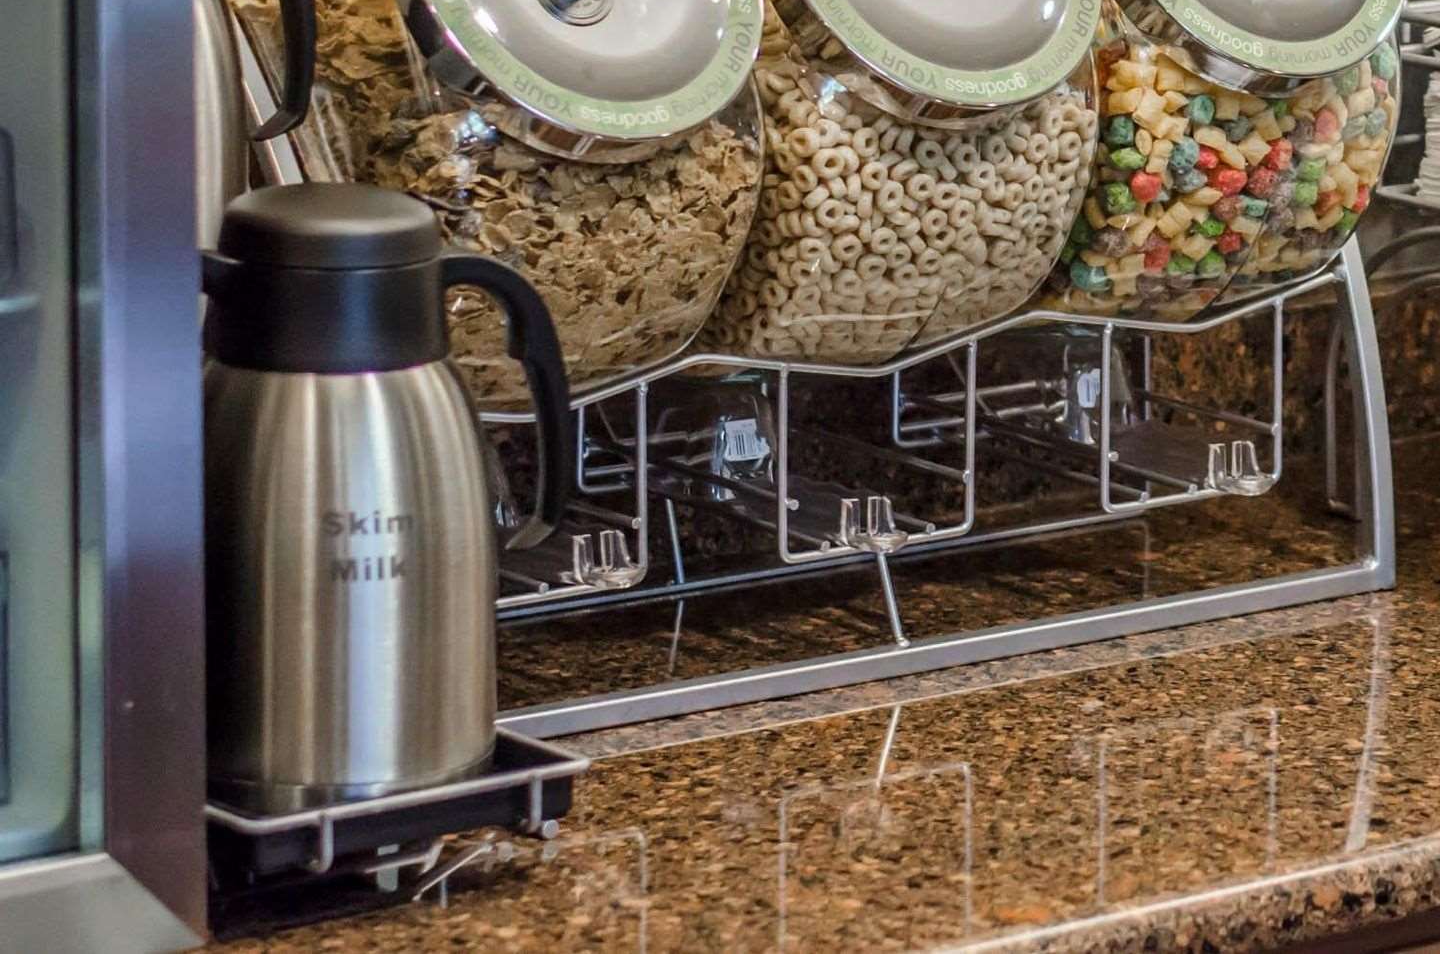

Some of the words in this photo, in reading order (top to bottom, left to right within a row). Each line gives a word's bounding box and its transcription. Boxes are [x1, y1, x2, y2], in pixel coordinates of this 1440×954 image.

[726, 22, 754, 73] YOUR
[1183, 7, 1263, 58] goodness
[1334, 22, 1376, 59] YOUR
[881, 50, 937, 88] YOUR
[944, 72, 1027, 97] goodness
[513, 75, 572, 118] YOUR
[581, 105, 670, 128] goodness
[322, 510, 414, 537] Skim
[330, 557, 406, 582] Milk
